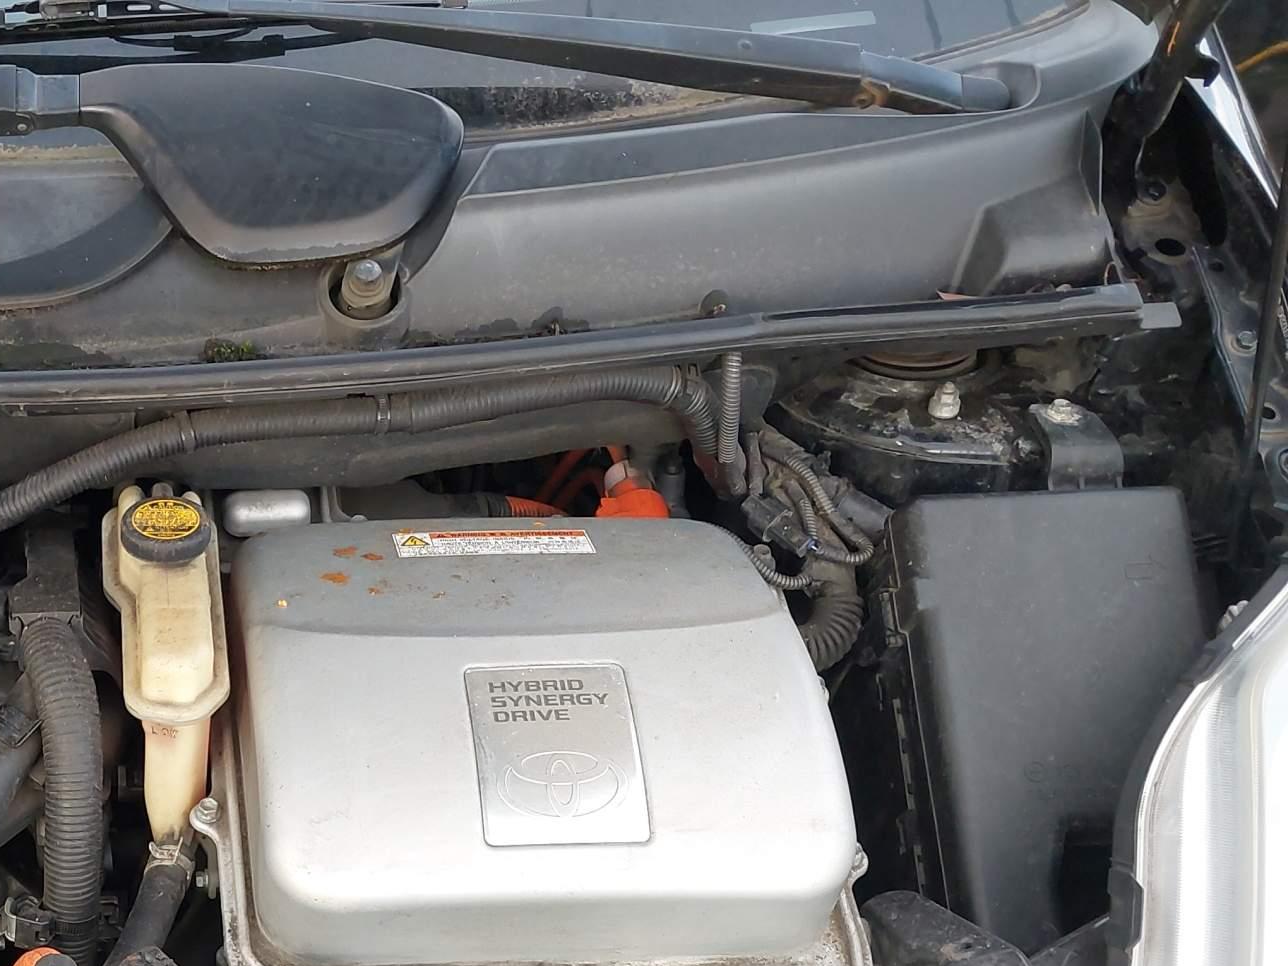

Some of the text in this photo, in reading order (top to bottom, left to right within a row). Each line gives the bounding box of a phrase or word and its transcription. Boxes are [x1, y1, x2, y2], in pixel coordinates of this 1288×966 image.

[488, 680, 584, 693] HYBRID
[490, 693, 609, 708] SYNERGY
[492, 709, 571, 722] DRIVE
